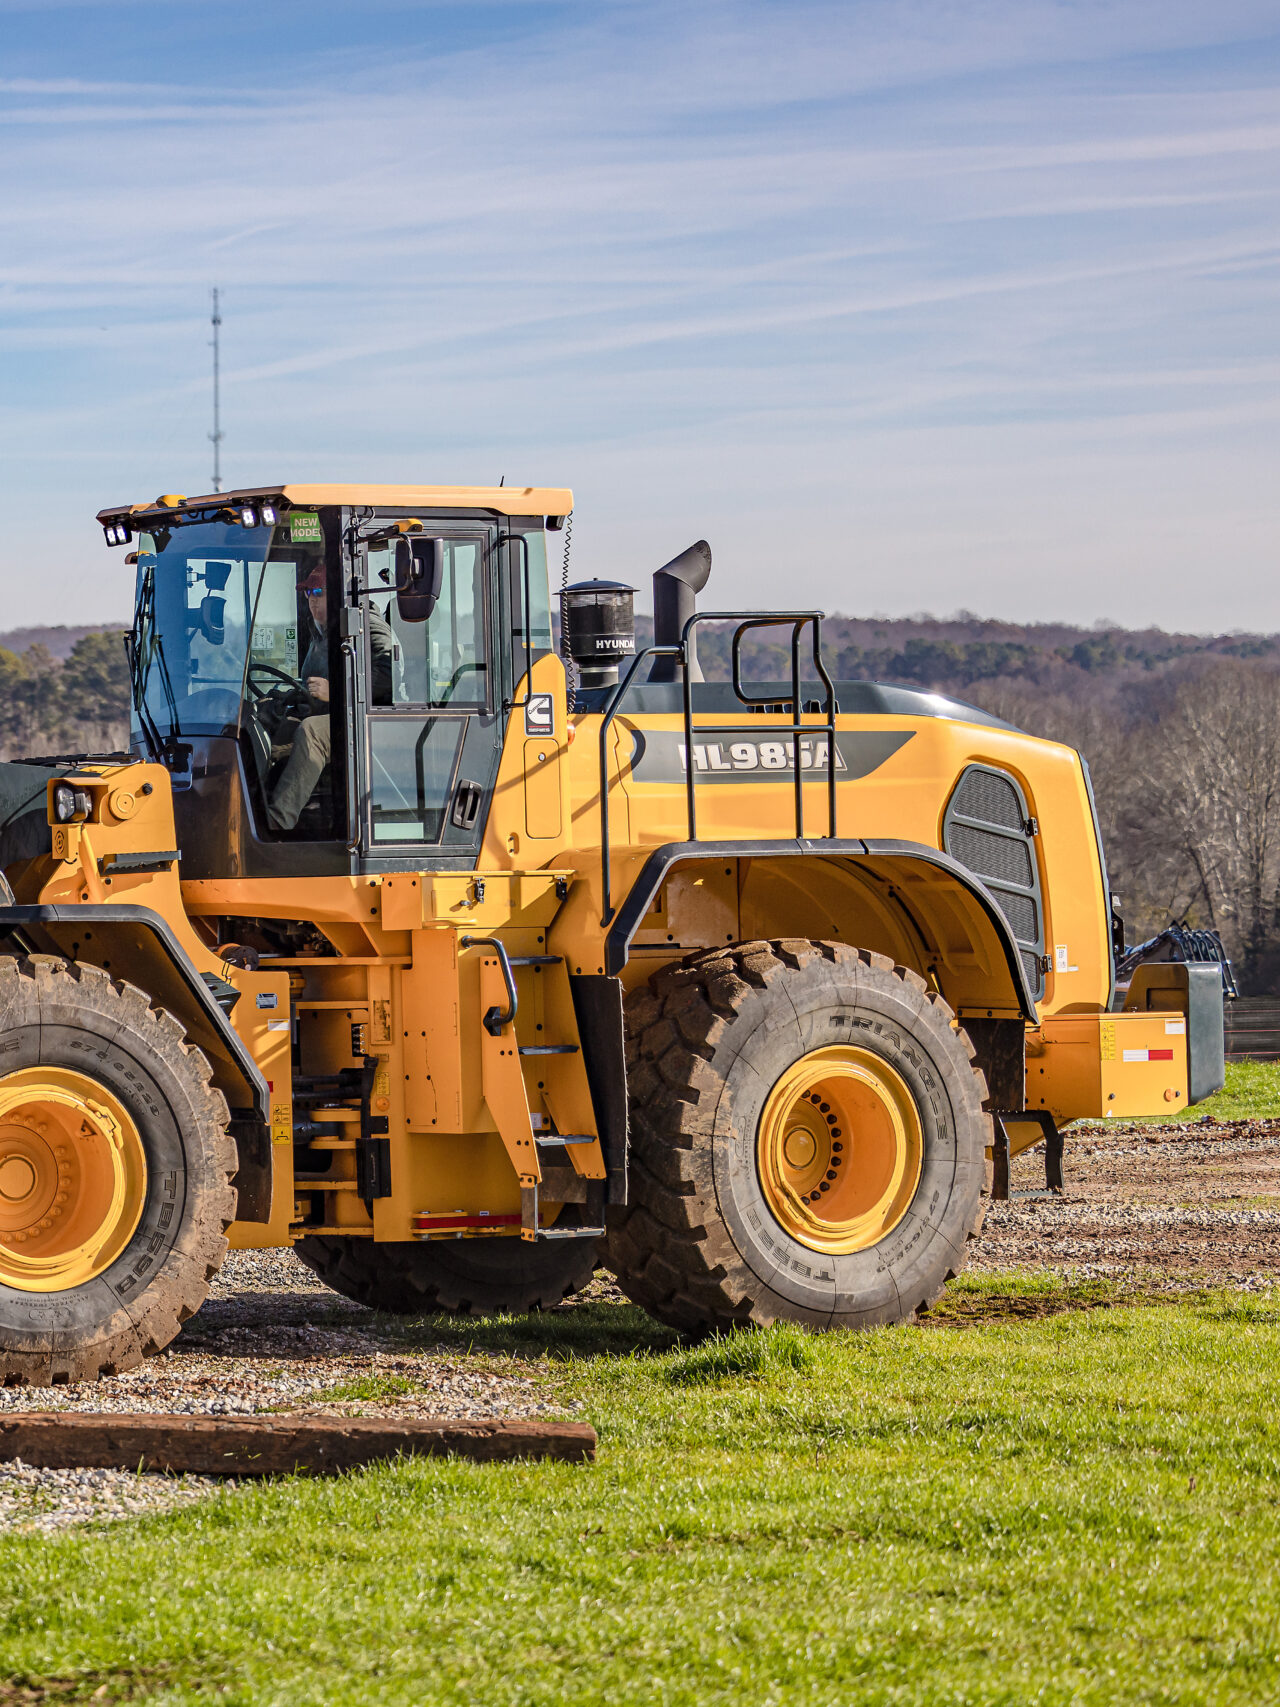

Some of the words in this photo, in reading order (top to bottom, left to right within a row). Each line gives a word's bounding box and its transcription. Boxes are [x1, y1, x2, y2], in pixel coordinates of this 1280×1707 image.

[294, 518, 318, 527] NEW
[595, 639, 635, 649] HYUNDA
[677, 741, 844, 771] HL985A
[829, 1015, 948, 1140] TRIANGLE
